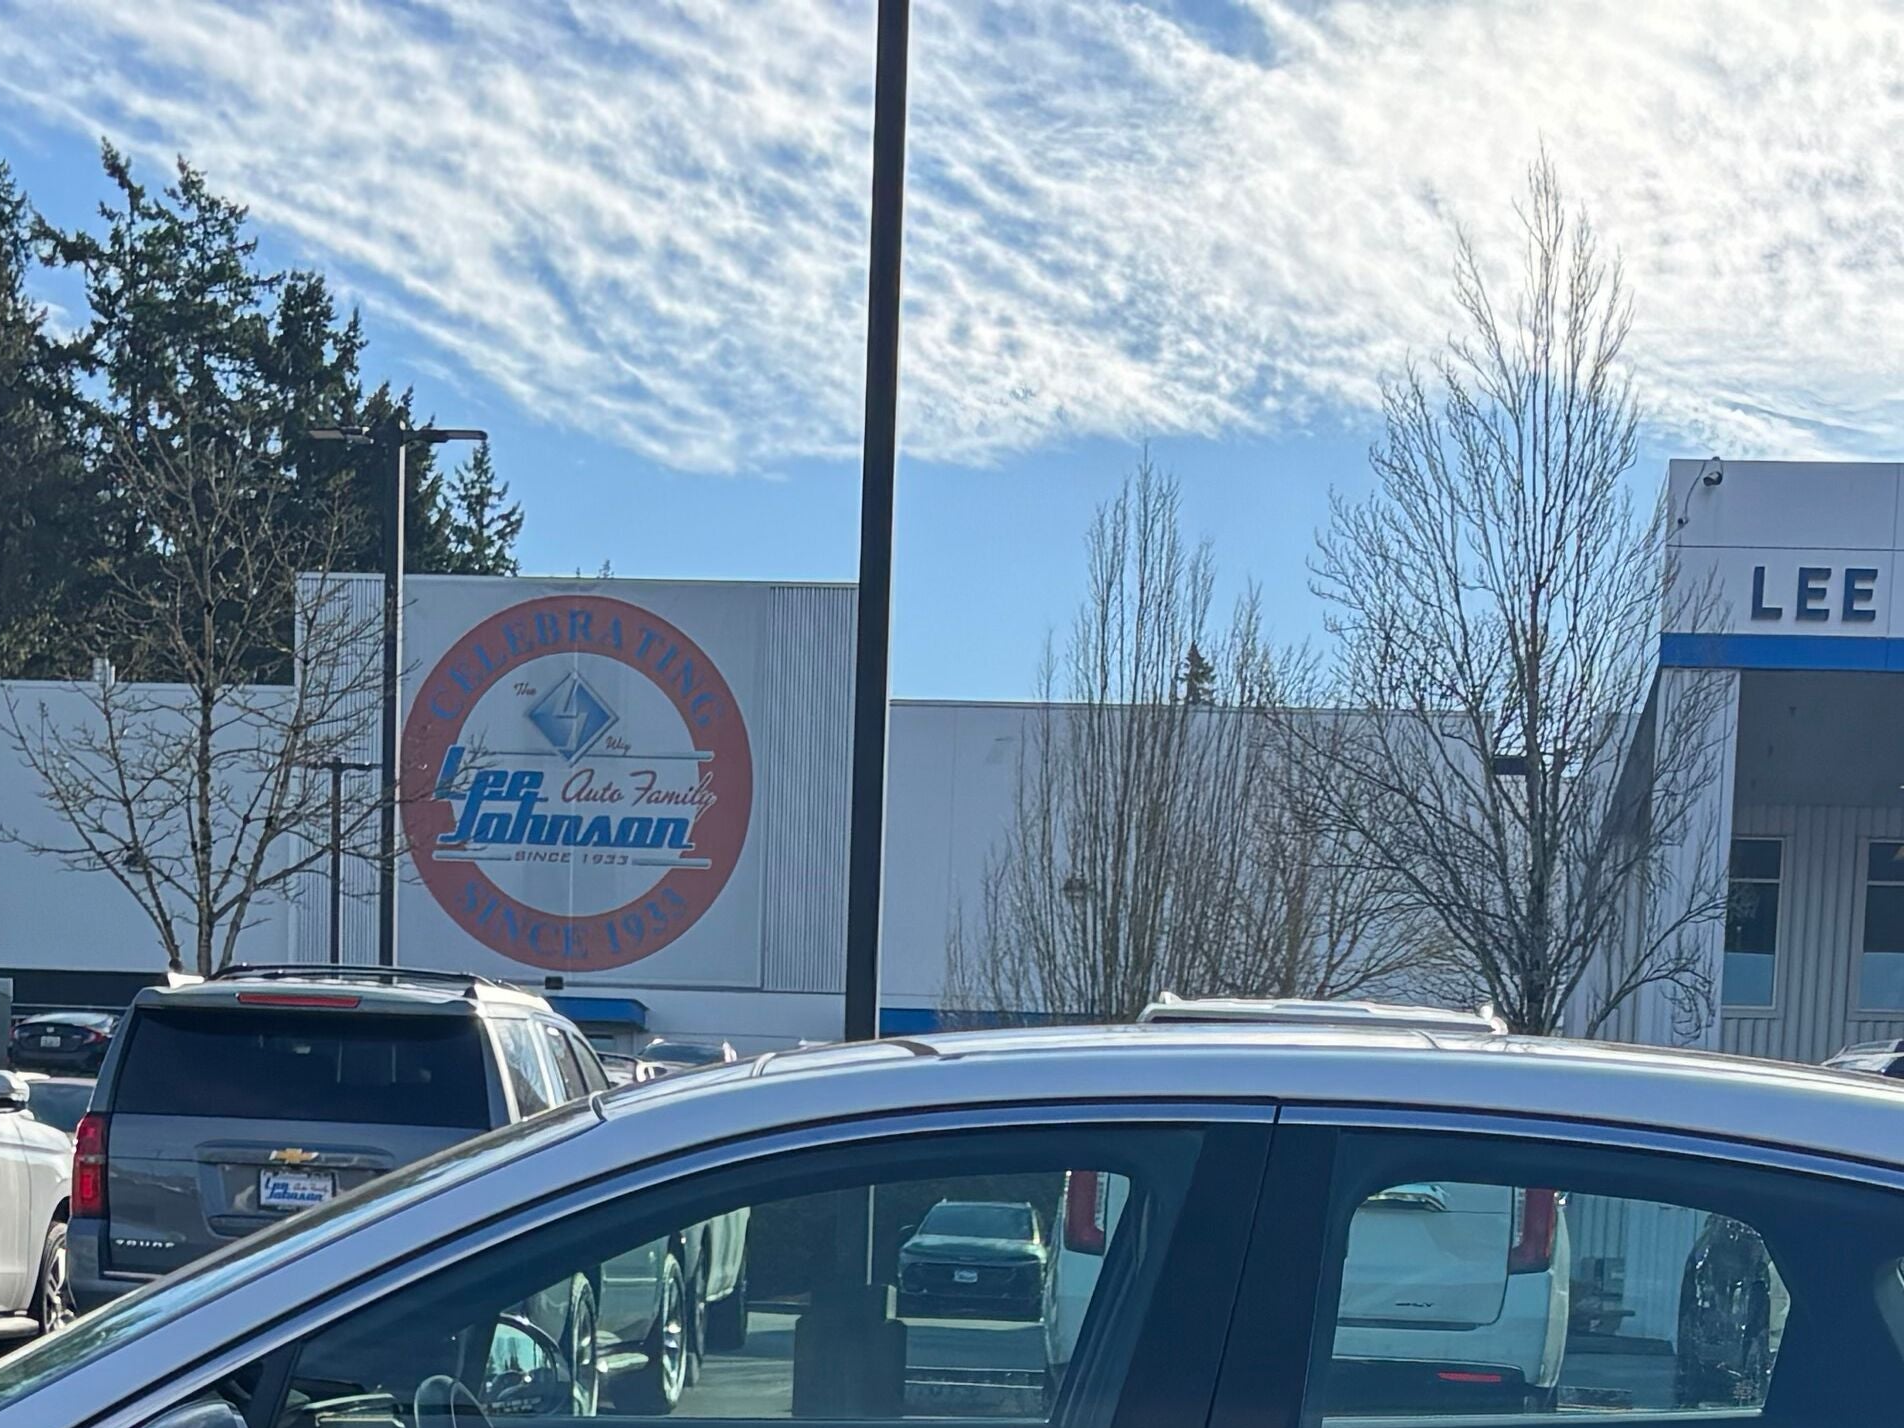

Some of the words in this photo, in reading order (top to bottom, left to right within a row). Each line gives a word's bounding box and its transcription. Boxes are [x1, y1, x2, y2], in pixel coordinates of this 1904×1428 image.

[1750, 566, 1879, 622] LEE
[428, 608, 726, 727] CELEBRATING
[432, 744, 549, 802] Lee
[561, 768, 625, 804] Auto
[629, 769, 718, 821] Family
[437, 797, 696, 850] Johnson
[514, 851, 572, 864] SINCE
[582, 853, 630, 866] 1933
[455, 880, 588, 959] SINCE
[605, 886, 689, 954] 1933
